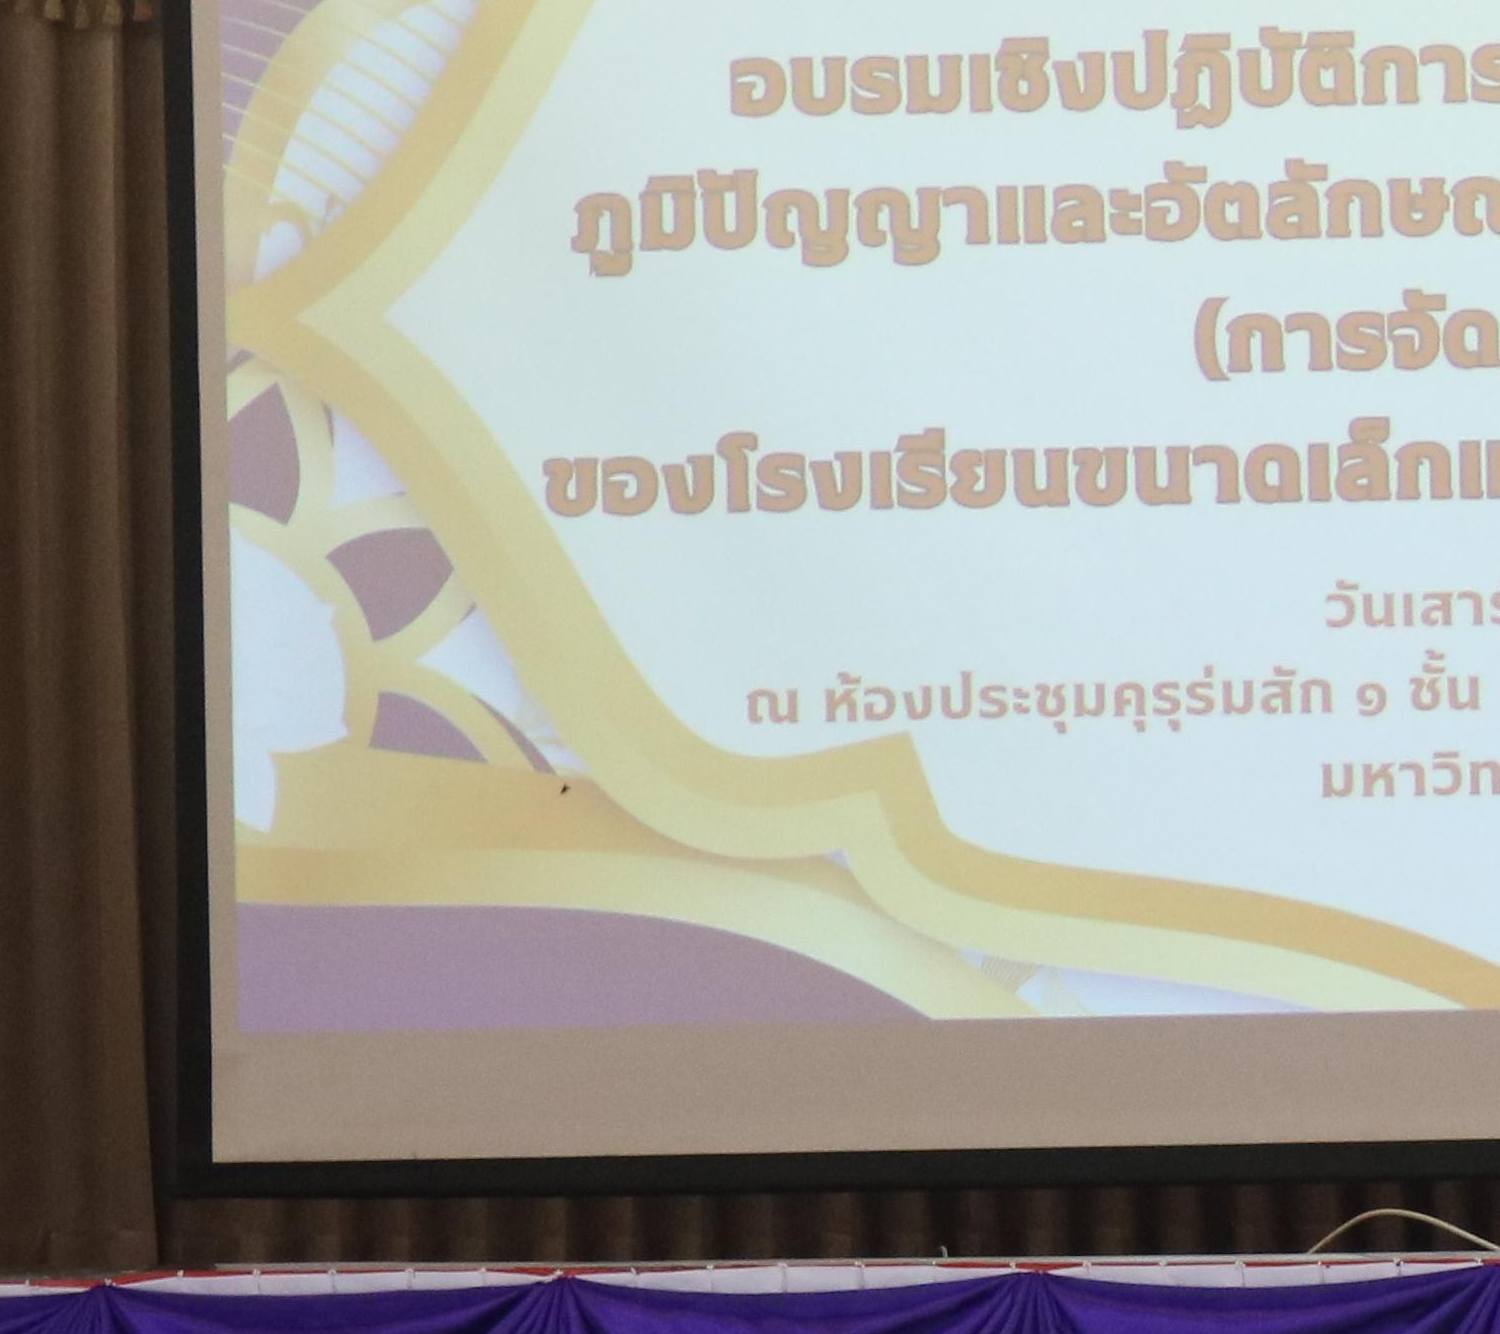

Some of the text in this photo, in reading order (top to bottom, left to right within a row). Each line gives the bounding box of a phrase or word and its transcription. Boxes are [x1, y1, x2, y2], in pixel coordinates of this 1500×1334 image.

[746, 687, 801, 725] ณ
[823, 665, 1335, 734] ห้องประชุมคุรุร่มสัก
[1356, 681, 1389, 716] ๑
[1409, 649, 1482, 711] ชั้น
